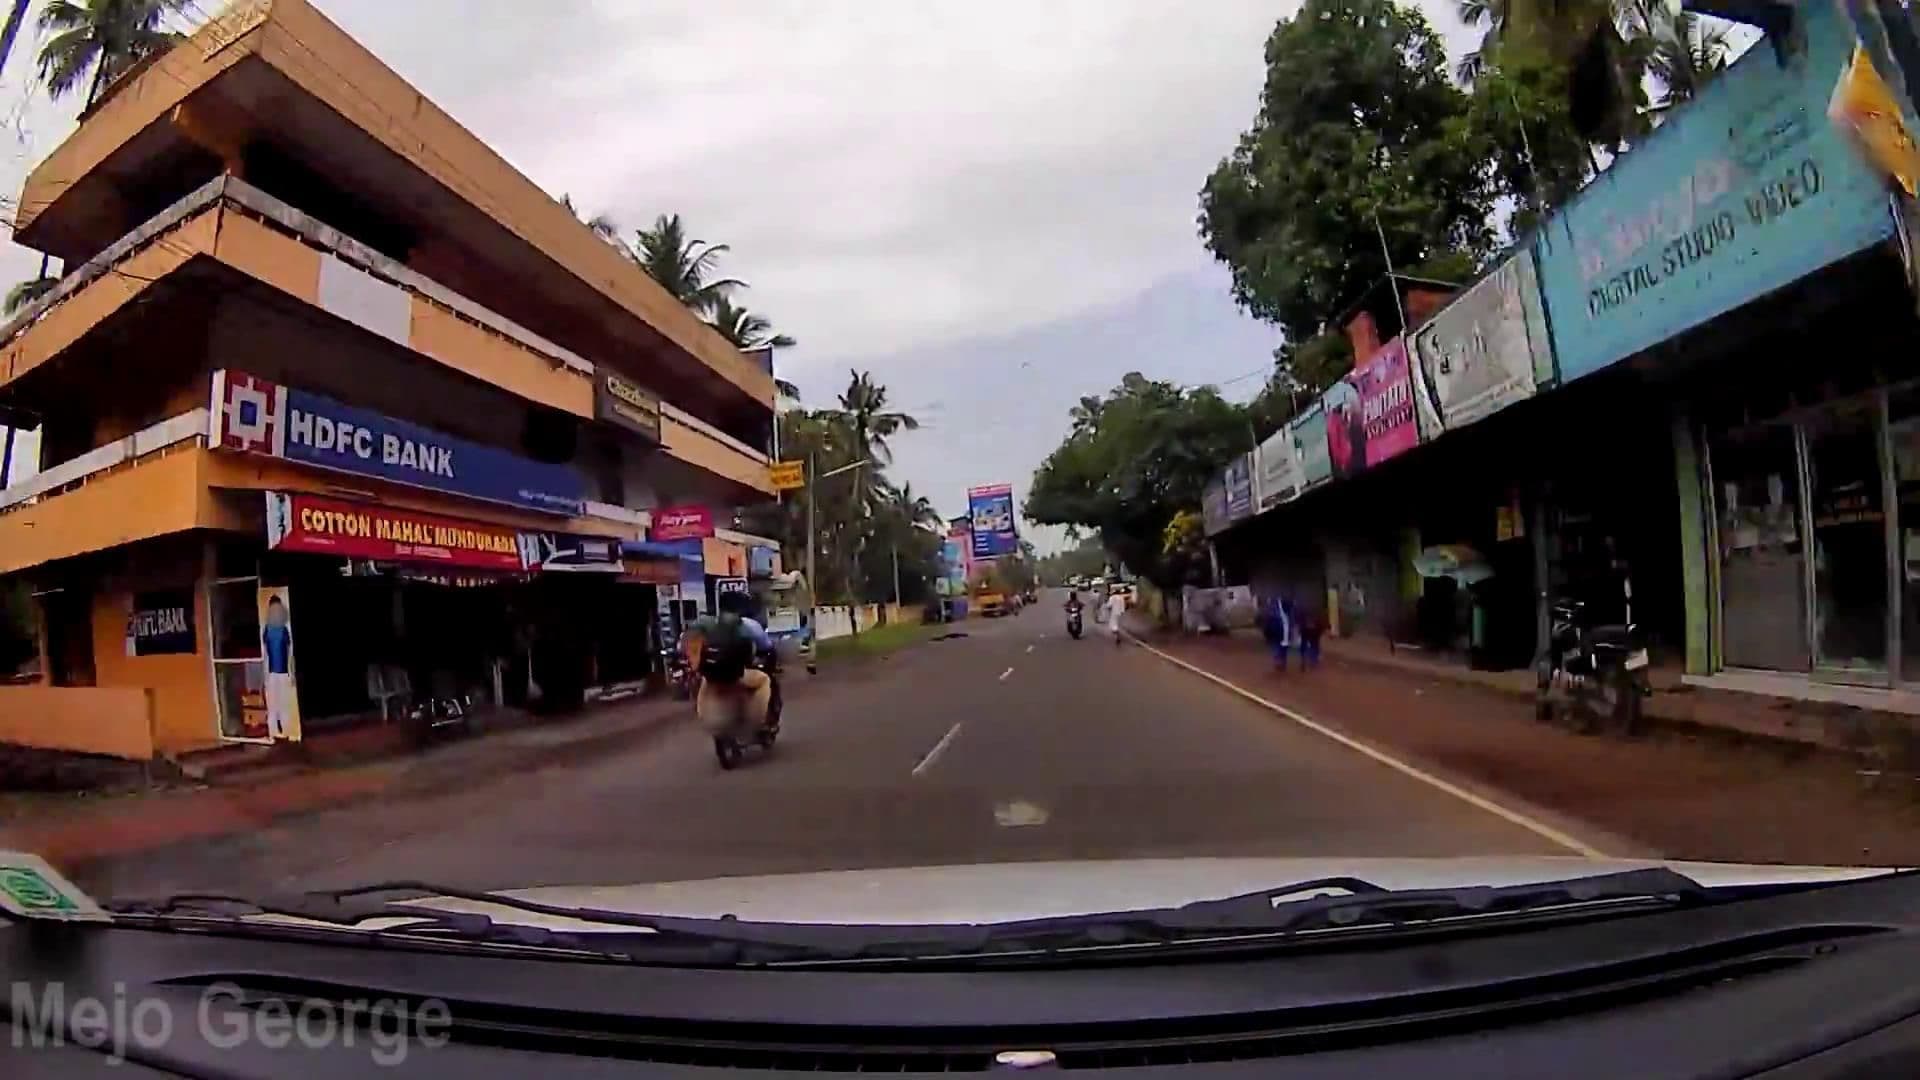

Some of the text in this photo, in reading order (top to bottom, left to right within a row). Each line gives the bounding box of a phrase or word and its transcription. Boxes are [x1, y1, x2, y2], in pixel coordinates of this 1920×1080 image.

[1588, 263, 1658, 319] DIGITAL
[1662, 209, 1736, 277] STUDIO
[1745, 157, 1822, 225] VIDEO
[290, 409, 454, 478] HDFC BANK
[301, 508, 371, 537] COTTON
[375, 517, 432, 545] MAHAL
[720, 581, 746, 593] ATM
[158, 607, 188, 634] BANK
